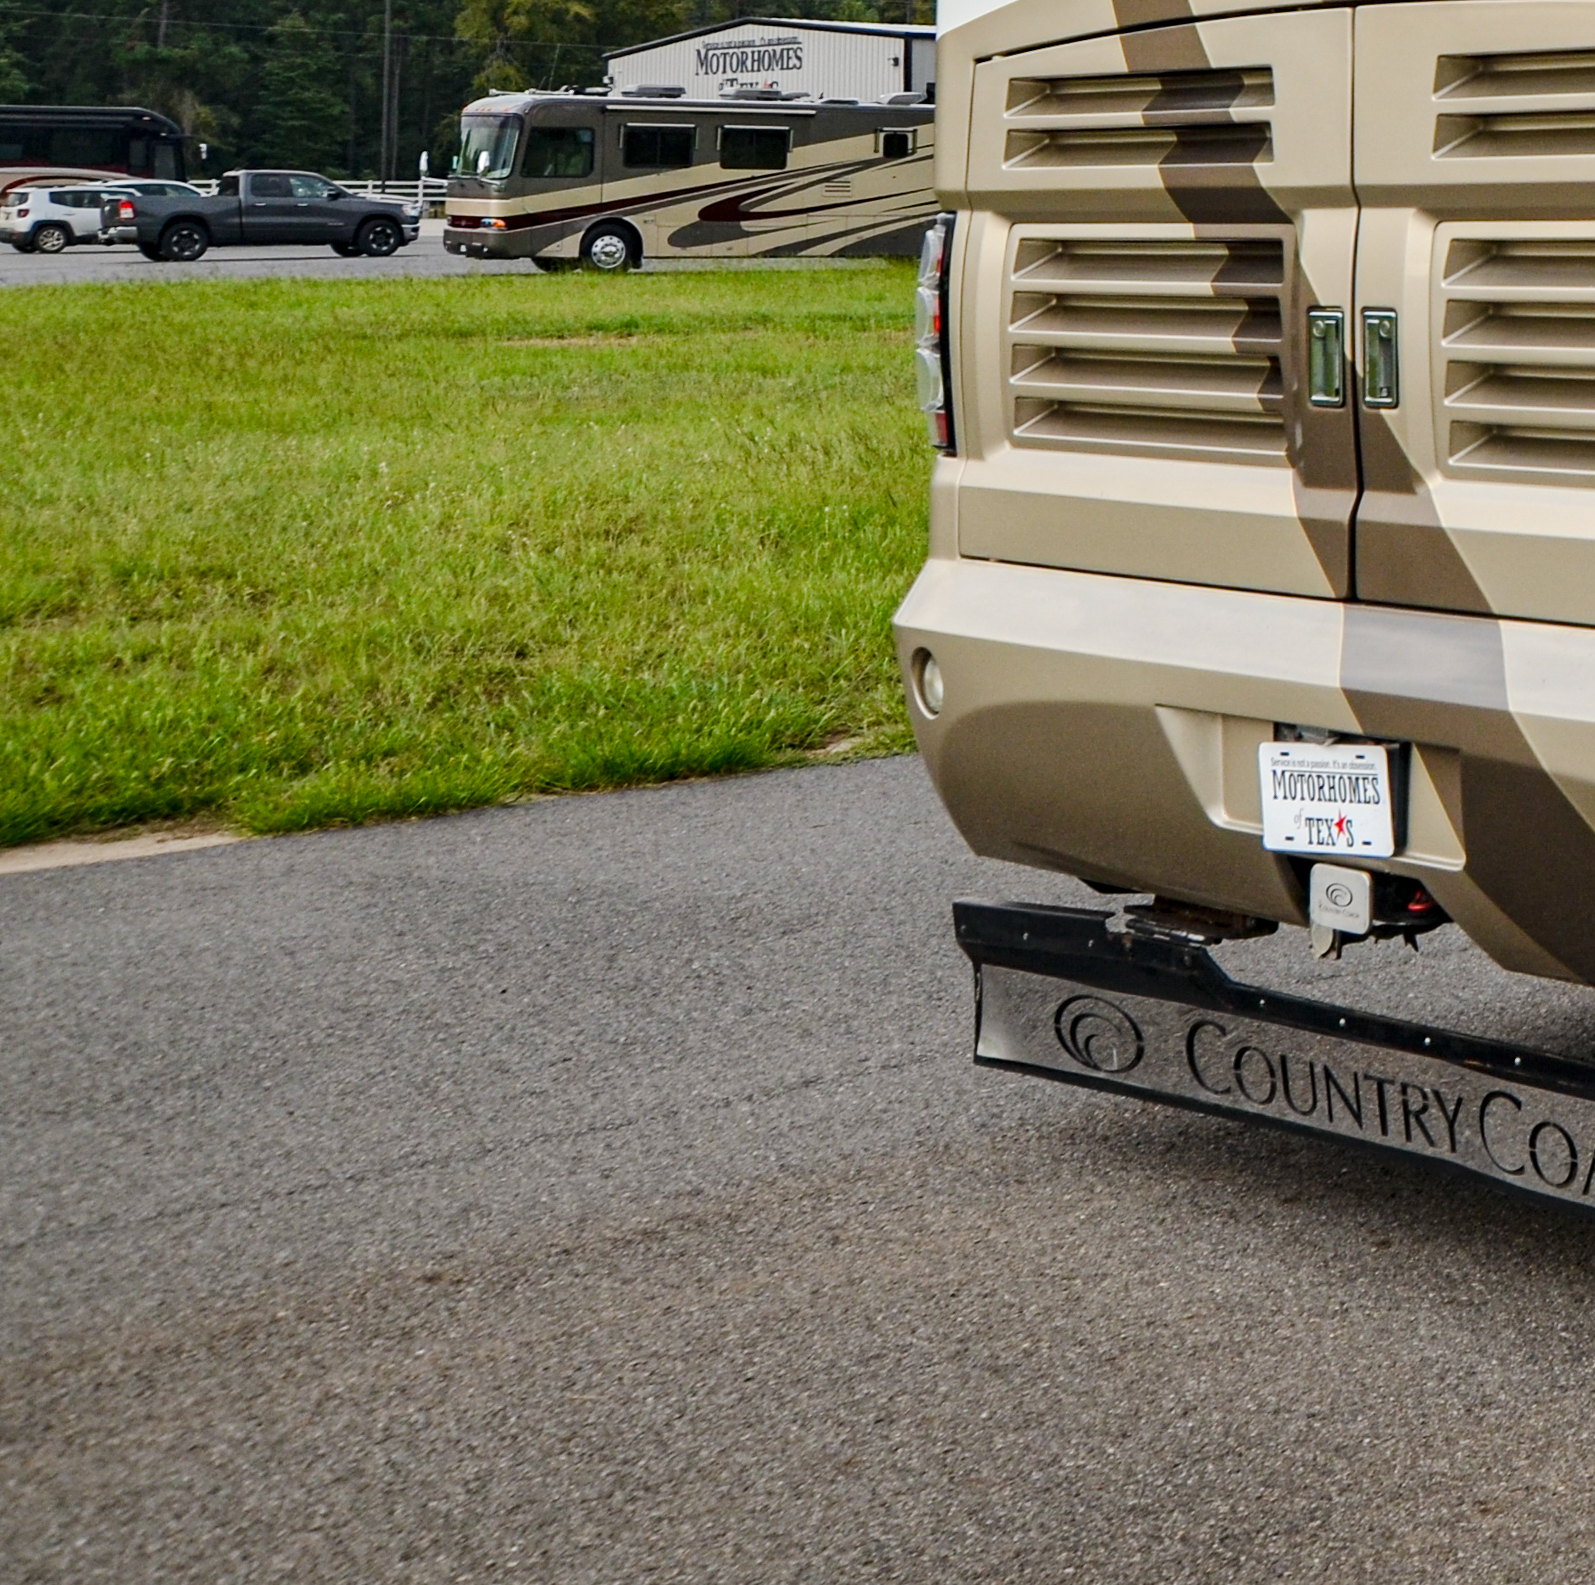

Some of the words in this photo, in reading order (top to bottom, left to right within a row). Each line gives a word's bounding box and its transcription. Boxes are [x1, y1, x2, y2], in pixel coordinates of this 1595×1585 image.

[695, 47, 803, 76] MOTORHOMES
[1272, 769, 1381, 804] MOTORHOMES
[1305, 817, 1354, 848] TEXS
